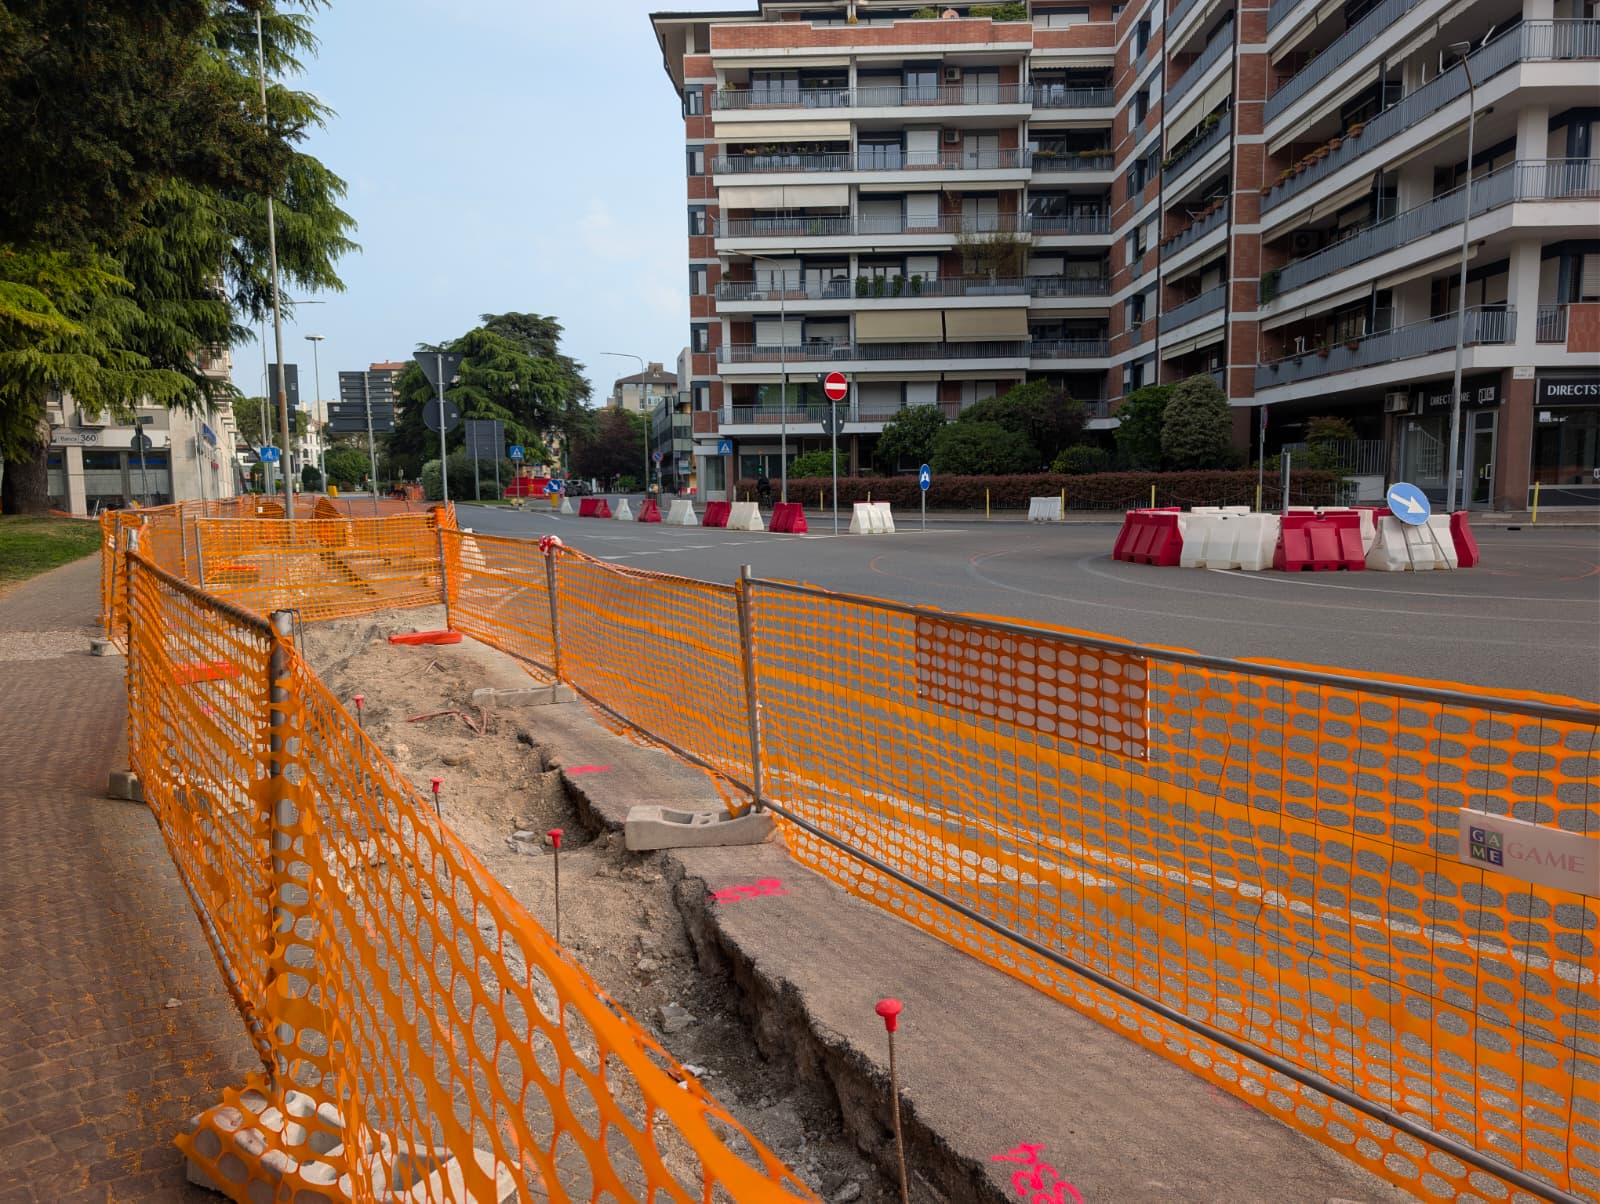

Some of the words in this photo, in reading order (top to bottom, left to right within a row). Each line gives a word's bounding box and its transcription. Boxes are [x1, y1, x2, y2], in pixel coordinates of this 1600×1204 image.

[1547, 384, 1600, 396] DIRECTS
[80, 433, 97, 442] 360
[1507, 841, 1585, 875] GAME
